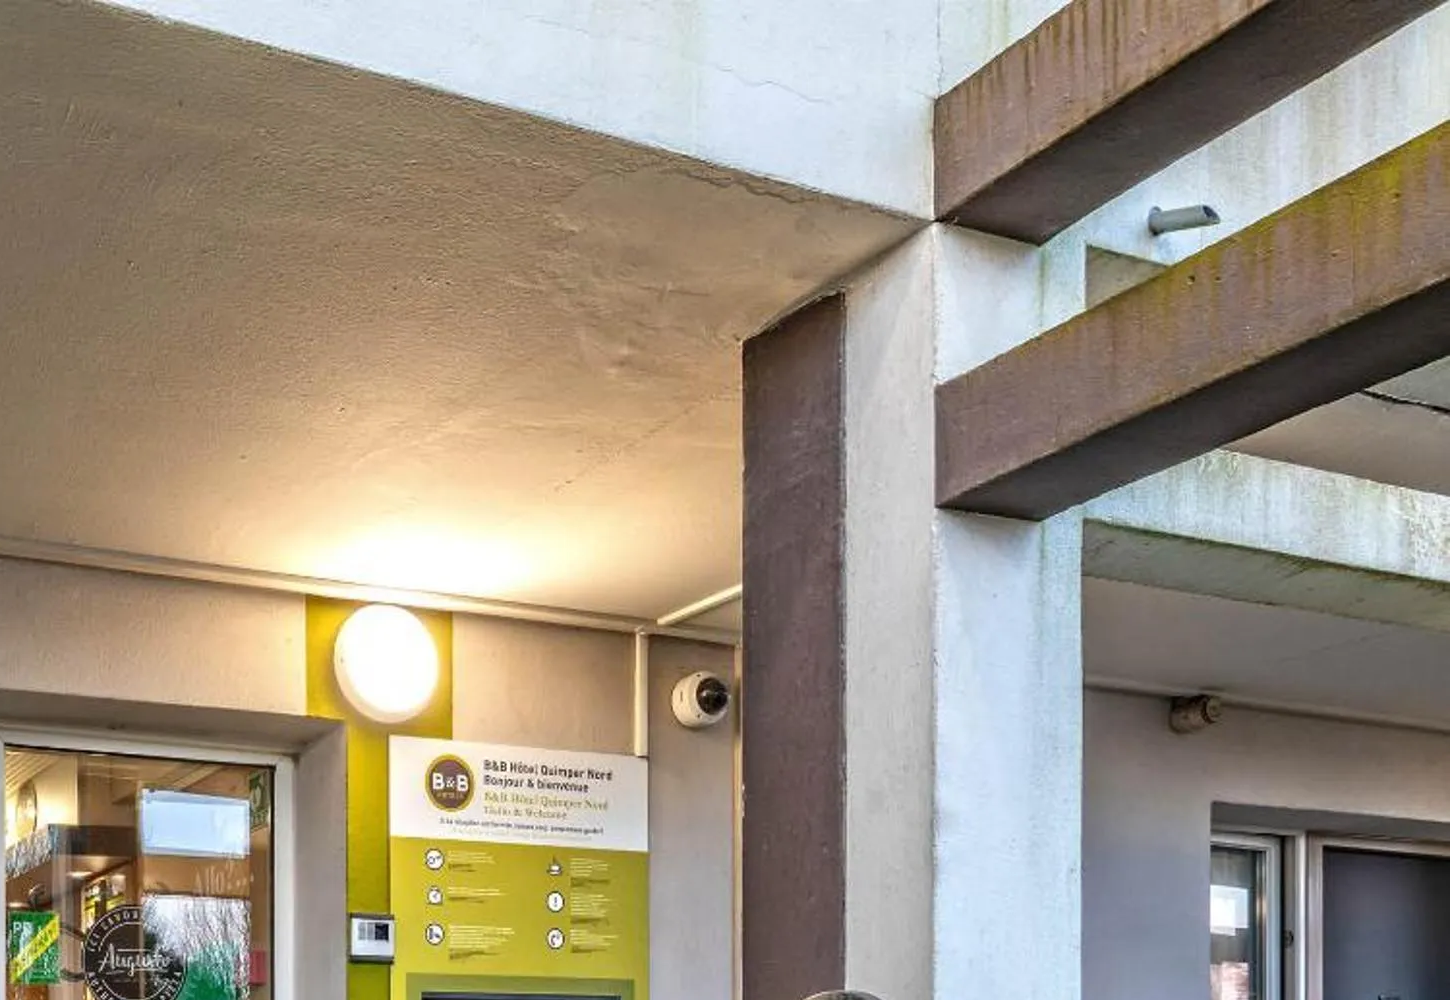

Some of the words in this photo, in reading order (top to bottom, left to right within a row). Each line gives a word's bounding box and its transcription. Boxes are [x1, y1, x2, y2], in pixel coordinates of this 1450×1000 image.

[484, 759, 507, 772] B&B
[510, 761, 538, 775] Hôtel
[541, 765, 584, 779] Quimper
[587, 769, 613, 781] Nord
[432, 772, 468, 792] B&B
[484, 774, 523, 789] Bonjour
[527, 778, 534, 788] &
[537, 779, 589, 793] bienvenue
